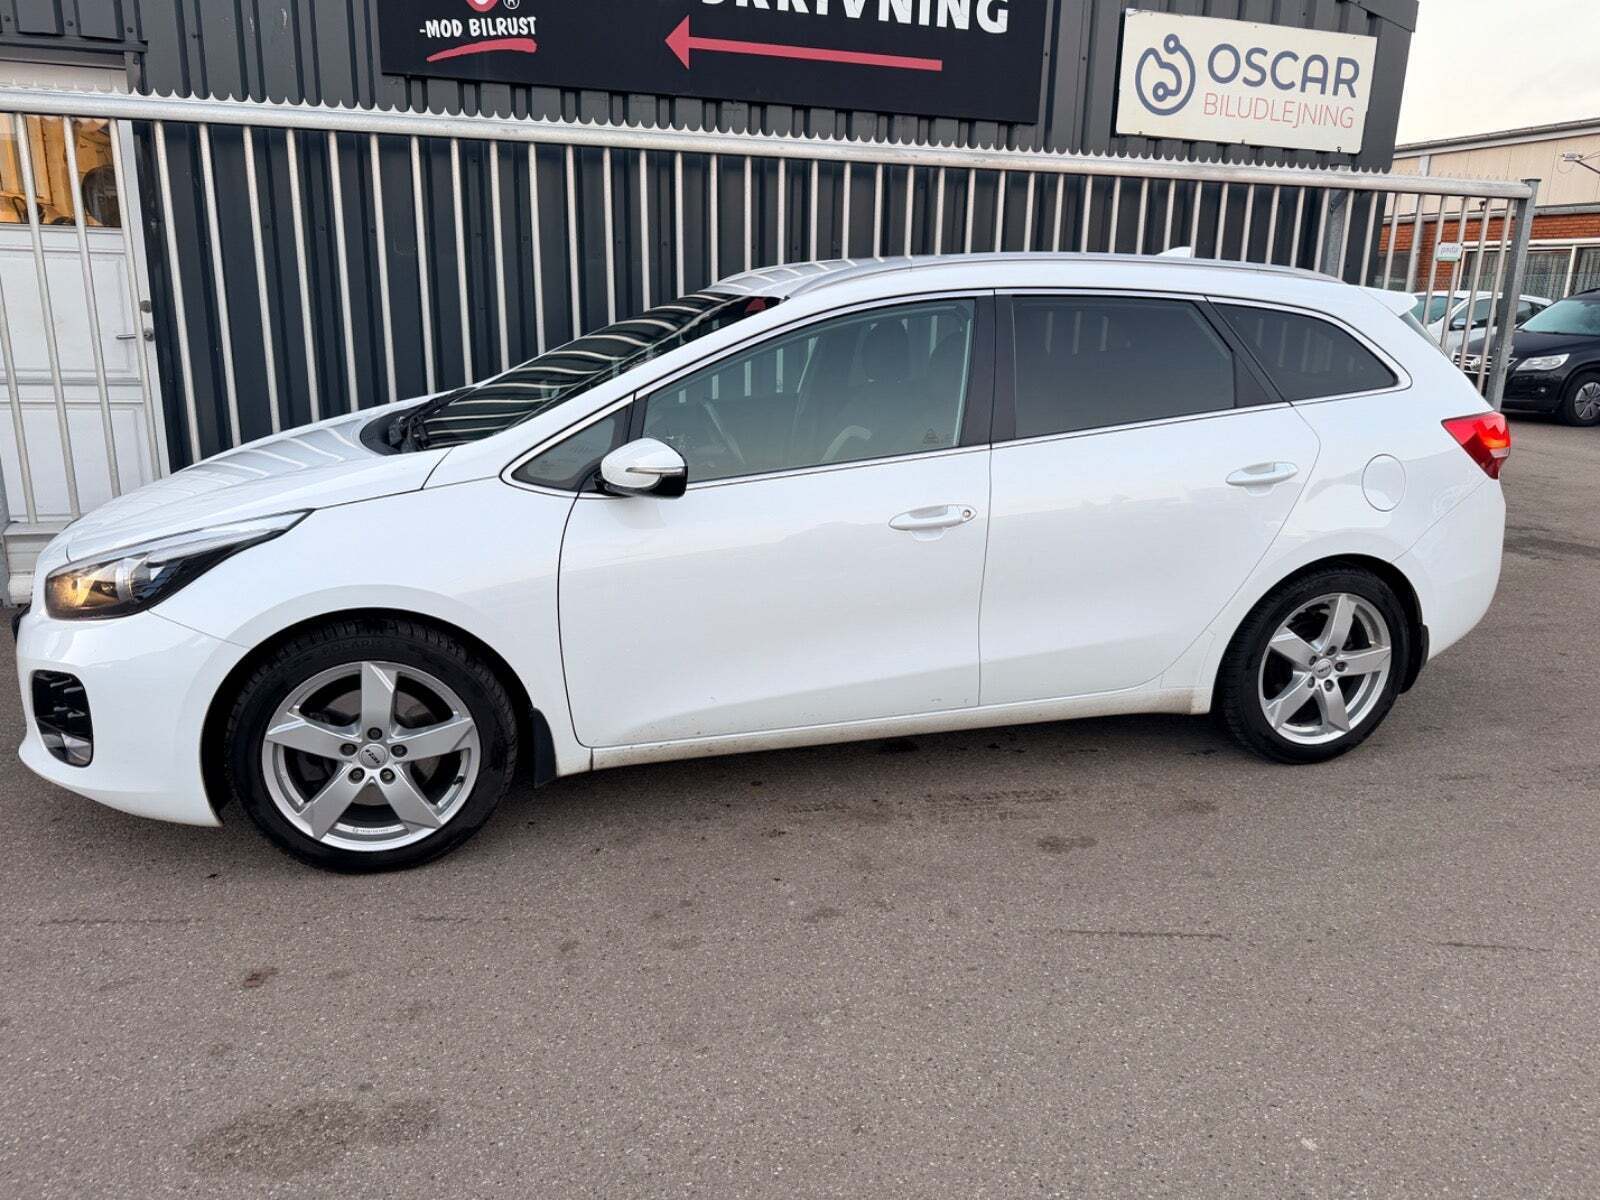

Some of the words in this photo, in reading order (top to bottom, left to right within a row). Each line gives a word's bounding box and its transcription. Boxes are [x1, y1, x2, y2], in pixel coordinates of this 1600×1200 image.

[419, 19, 463, 38] -MOD
[469, 16, 537, 37] BILRUST
[1207, 43, 1360, 98] OSCAR
[1203, 92, 1355, 129] BILUDLEJNING
